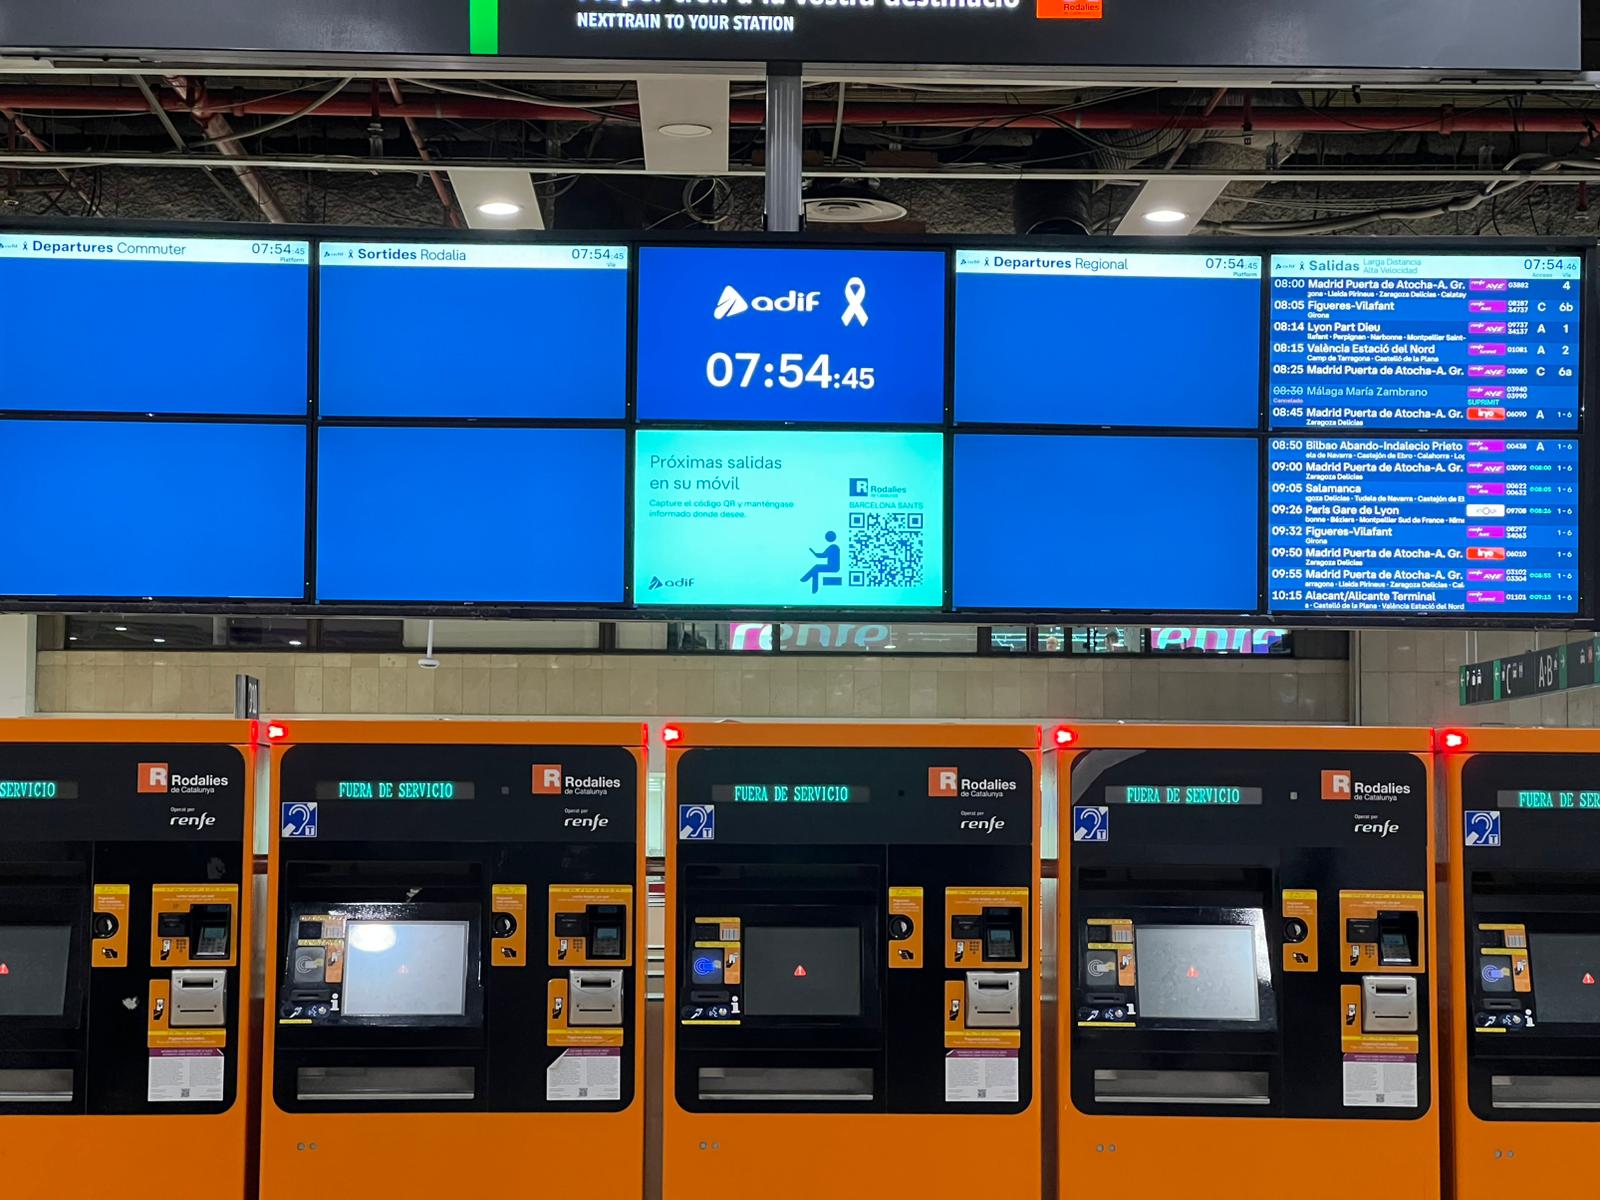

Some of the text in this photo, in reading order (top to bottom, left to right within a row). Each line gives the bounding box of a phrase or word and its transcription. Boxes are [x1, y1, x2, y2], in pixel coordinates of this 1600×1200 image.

[1064, 3, 1099, 11] Rodalies
[664, 14, 685, 29] TO
[688, 15, 729, 31] YOUR
[732, 16, 794, 32] STATION
[32, 240, 114, 254] Departures
[117, 241, 187, 255] Commuter
[358, 248, 417, 260] Sortides
[420, 249, 467, 261] Rodalia
[994, 256, 1072, 270] Departures
[1075, 258, 1128, 272] Regional
[1309, 260, 1360, 272] Salidas
[1362, 258, 1386, 268] Larga
[1387, 258, 1422, 266] Distancia
[1274, 278, 1304, 288] 08:00
[1308, 279, 1344, 290] Madrid
[1346, 280, 1379, 290] Puerta
[1381, 280, 1394, 289] de
[1396, 280, 1448, 290] Atocha-A.
[1450, 280, 1466, 290] Gr.
[1562, 281, 1570, 290] 4
[751, 290, 821, 312] adif
[1274, 300, 1574, 312] 08:05 Figueres-Vilafant C 6b
[1274, 322, 1569, 334] 08:14 Lyon Part Dieu A 1
[1274, 343, 1569, 355] 08:15 València Estació del Nord A 2
[706, 352, 875, 389] 07:54:45
[1273, 364, 1572, 376] 08:25 Madrid Puerta de Atocha-A. Gr. C 6a
[1307, 386, 1343, 397] Málaga
[1346, 386, 1374, 396] María
[1376, 387, 1428, 396] Zambrano
[1273, 407, 1545, 419] 08:45 Madrid Puerta de Atocha-A. Gr. A
[1272, 440, 1303, 450] 08:50
[1306, 441, 1338, 450] Bilbao
[1340, 441, 1430, 451] Abando-Indalecio
[1432, 441, 1463, 451] Prieto
[1536, 442, 1545, 451] A
[650, 454, 782, 469] Próximas salidas
[1272, 462, 1303, 471] 09:00
[1305, 462, 1342, 472] Madrid
[1343, 462, 1377, 472] Puerta
[1379, 462, 1392, 472] de
[1394, 463, 1446, 472] Atocha-A.
[1448, 463, 1464, 472] Gr.
[650, 476, 740, 490] en su móvil
[1272, 483, 1362, 493] 09:05 Salamanca
[649, 499, 682, 508] Capture
[693, 500, 721, 508] código
[744, 500, 794, 509] manténgase
[1272, 505, 1399, 517] 09:26 Paris Gare de Lyon
[1272, 526, 1392, 537] 09:32 Figueres-Vilafant
[664, 578, 695, 588] adif
[1272, 590, 1436, 601] 10:15 Alacant/Alicante Terminal
[171, 774, 228, 786] Rodalies
[565, 776, 621, 788] Rodalies
[961, 778, 1017, 791] Rodalies
[0, 782, 56, 798] SERVICIO
[338, 782, 453, 798] FUERA DE SERVICIO
[575, 788, 608, 796] Catalunya
[734, 786, 849, 802] FUERA DE SERVICIO
[1354, 782, 1411, 795] Rodalies
[1127, 787, 1240, 803] FUERA DE SERVICIO
[1364, 794, 1398, 802] Catalunya
[1519, 792, 1553, 808] FUERA
[1560, 792, 1574, 808] DE
[170, 812, 216, 830] renfe
[564, 814, 609, 832] renfe
[961, 816, 1005, 834] renfe
[1354, 820, 1400, 838] renfe
